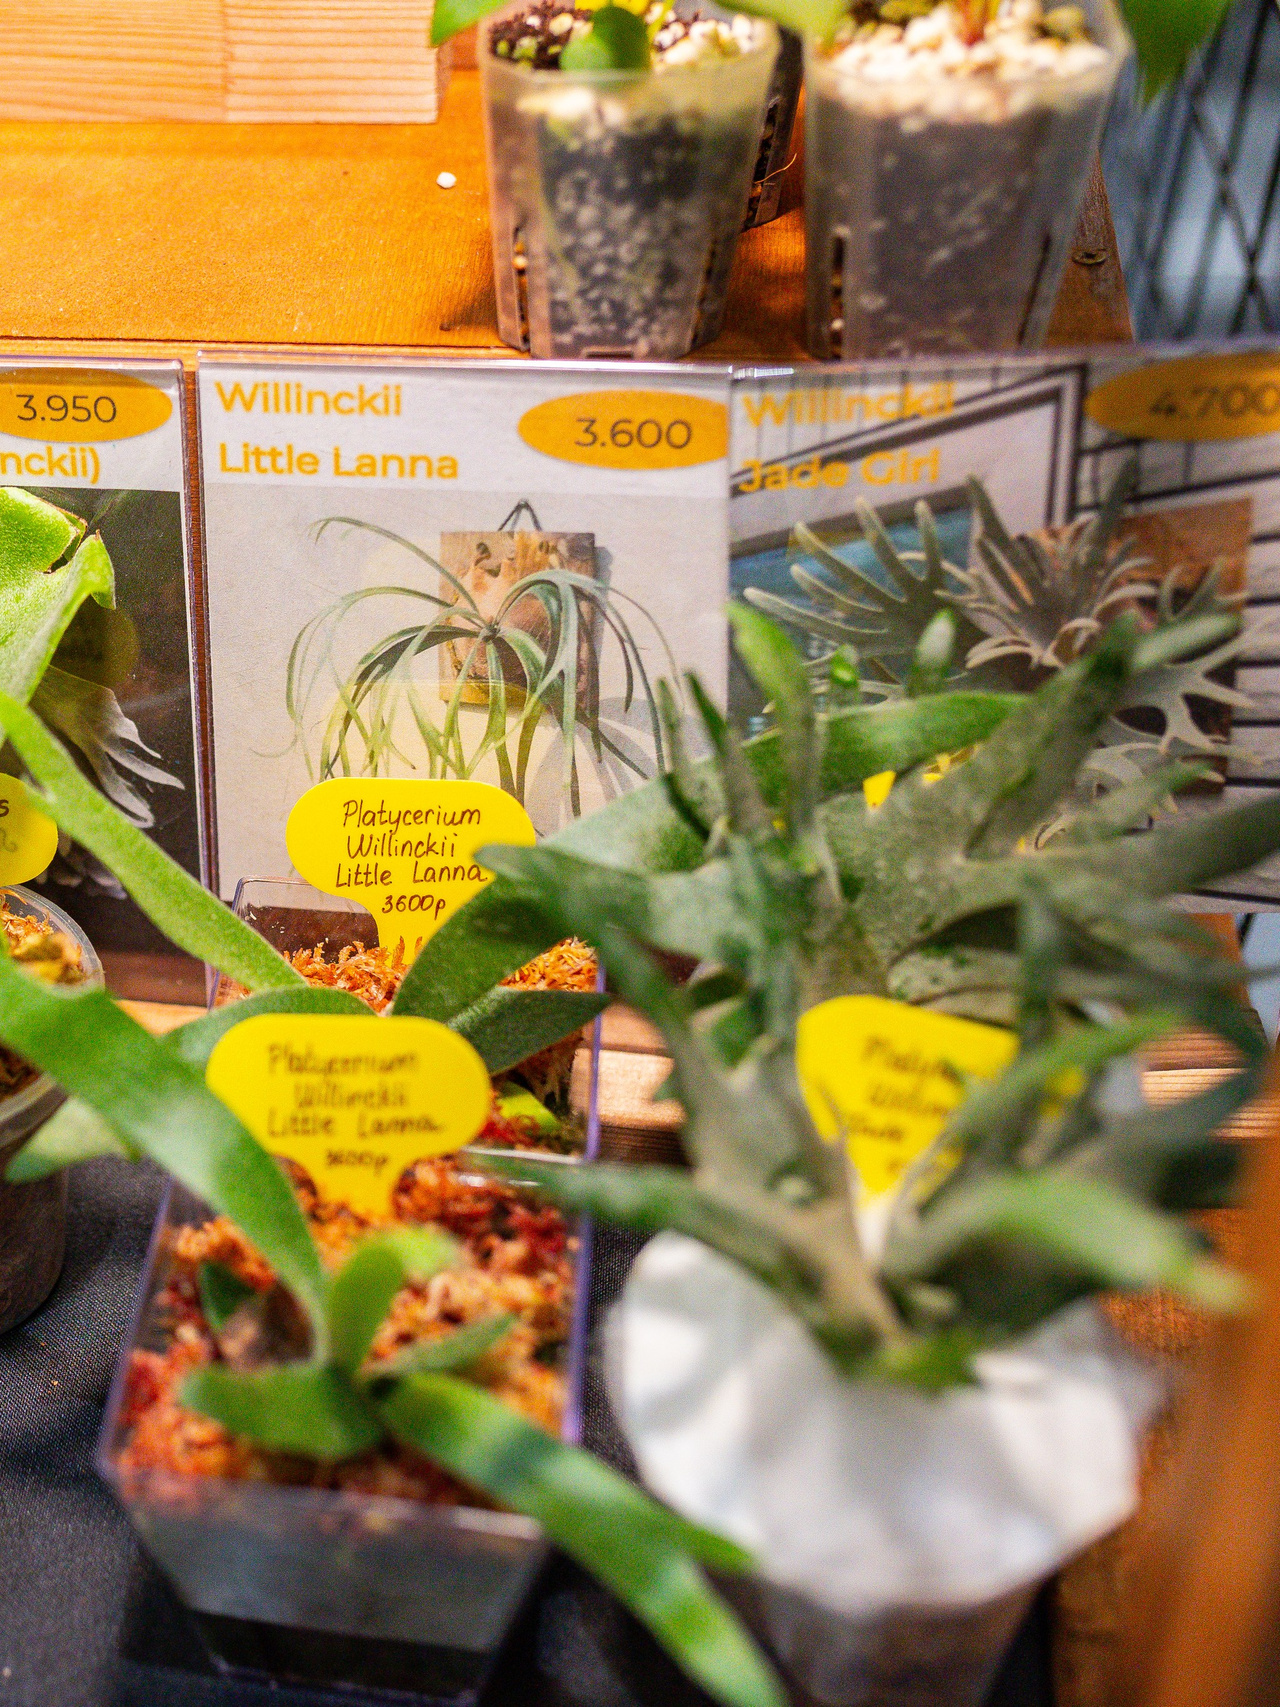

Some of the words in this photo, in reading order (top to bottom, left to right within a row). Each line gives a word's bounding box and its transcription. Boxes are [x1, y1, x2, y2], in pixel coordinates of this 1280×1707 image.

[15, 393, 118, 424] 3.950
[214, 381, 403, 417] Willinckii
[574, 417, 693, 450] 3.600
[218, 443, 320, 476] Little
[333, 446, 460, 480] Lanna
[738, 454, 851, 493] Jade
[860, 446, 942, 487] Girl
[342, 799, 482, 835] Platycerium
[347, 832, 459, 859] Willinckii
[335, 862, 393, 888] Little
[412, 860, 489, 884] Lanna
